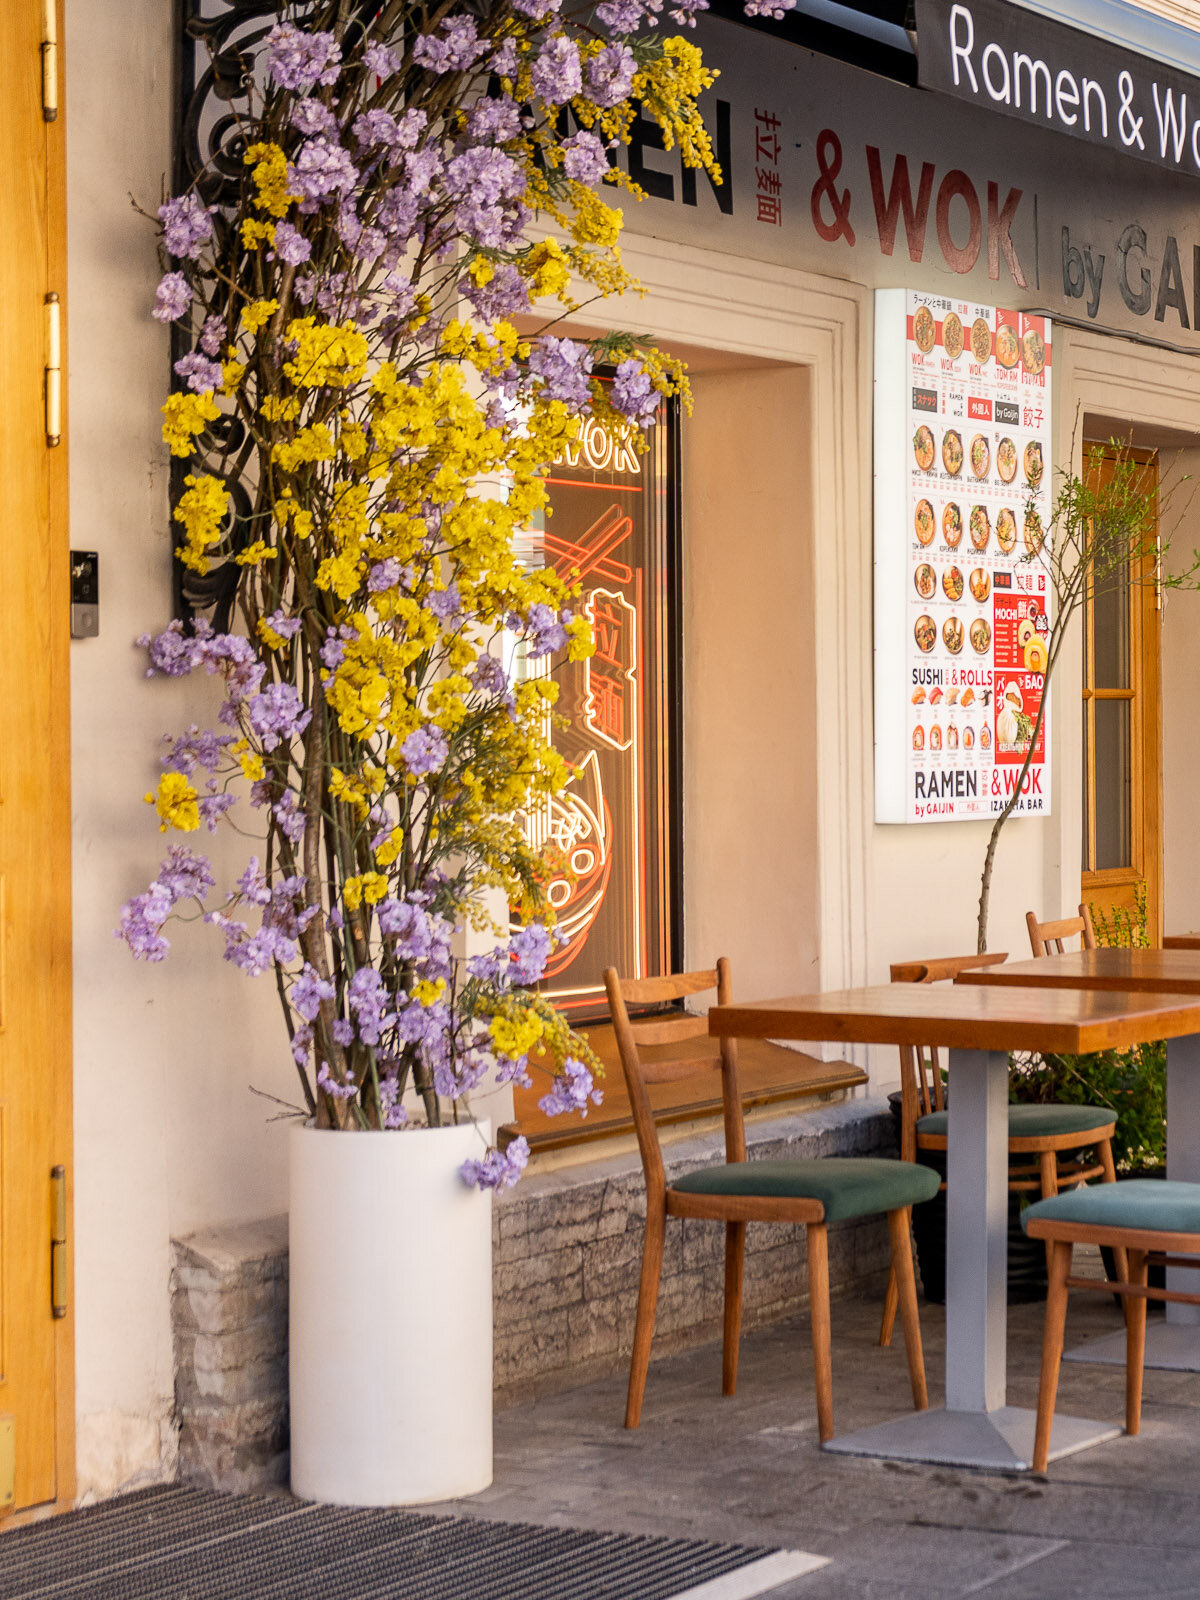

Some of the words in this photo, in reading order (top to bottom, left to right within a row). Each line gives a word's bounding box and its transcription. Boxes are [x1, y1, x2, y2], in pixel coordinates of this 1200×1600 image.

[949, 3, 1107, 138] Ramen
[1117, 70, 1145, 151] &
[810, 128, 857, 248] &
[865, 144, 1029, 290] WOK
[1061, 225, 1106, 320] by
[995, 608, 1018, 620] MOCHI
[912, 668, 943, 686] SUSHI
[951, 668, 958, 686] &
[960, 669, 993, 686] ROLLS
[1025, 674, 1044, 690] БАО
[915, 770, 977, 799] RAMEN
[991, 768, 1002, 796] &
[1003, 768, 1042, 796] WOK
[915, 803, 924, 818] by
[926, 802, 954, 815] GAIJIN
[1028, 799, 1043, 810] BAR
